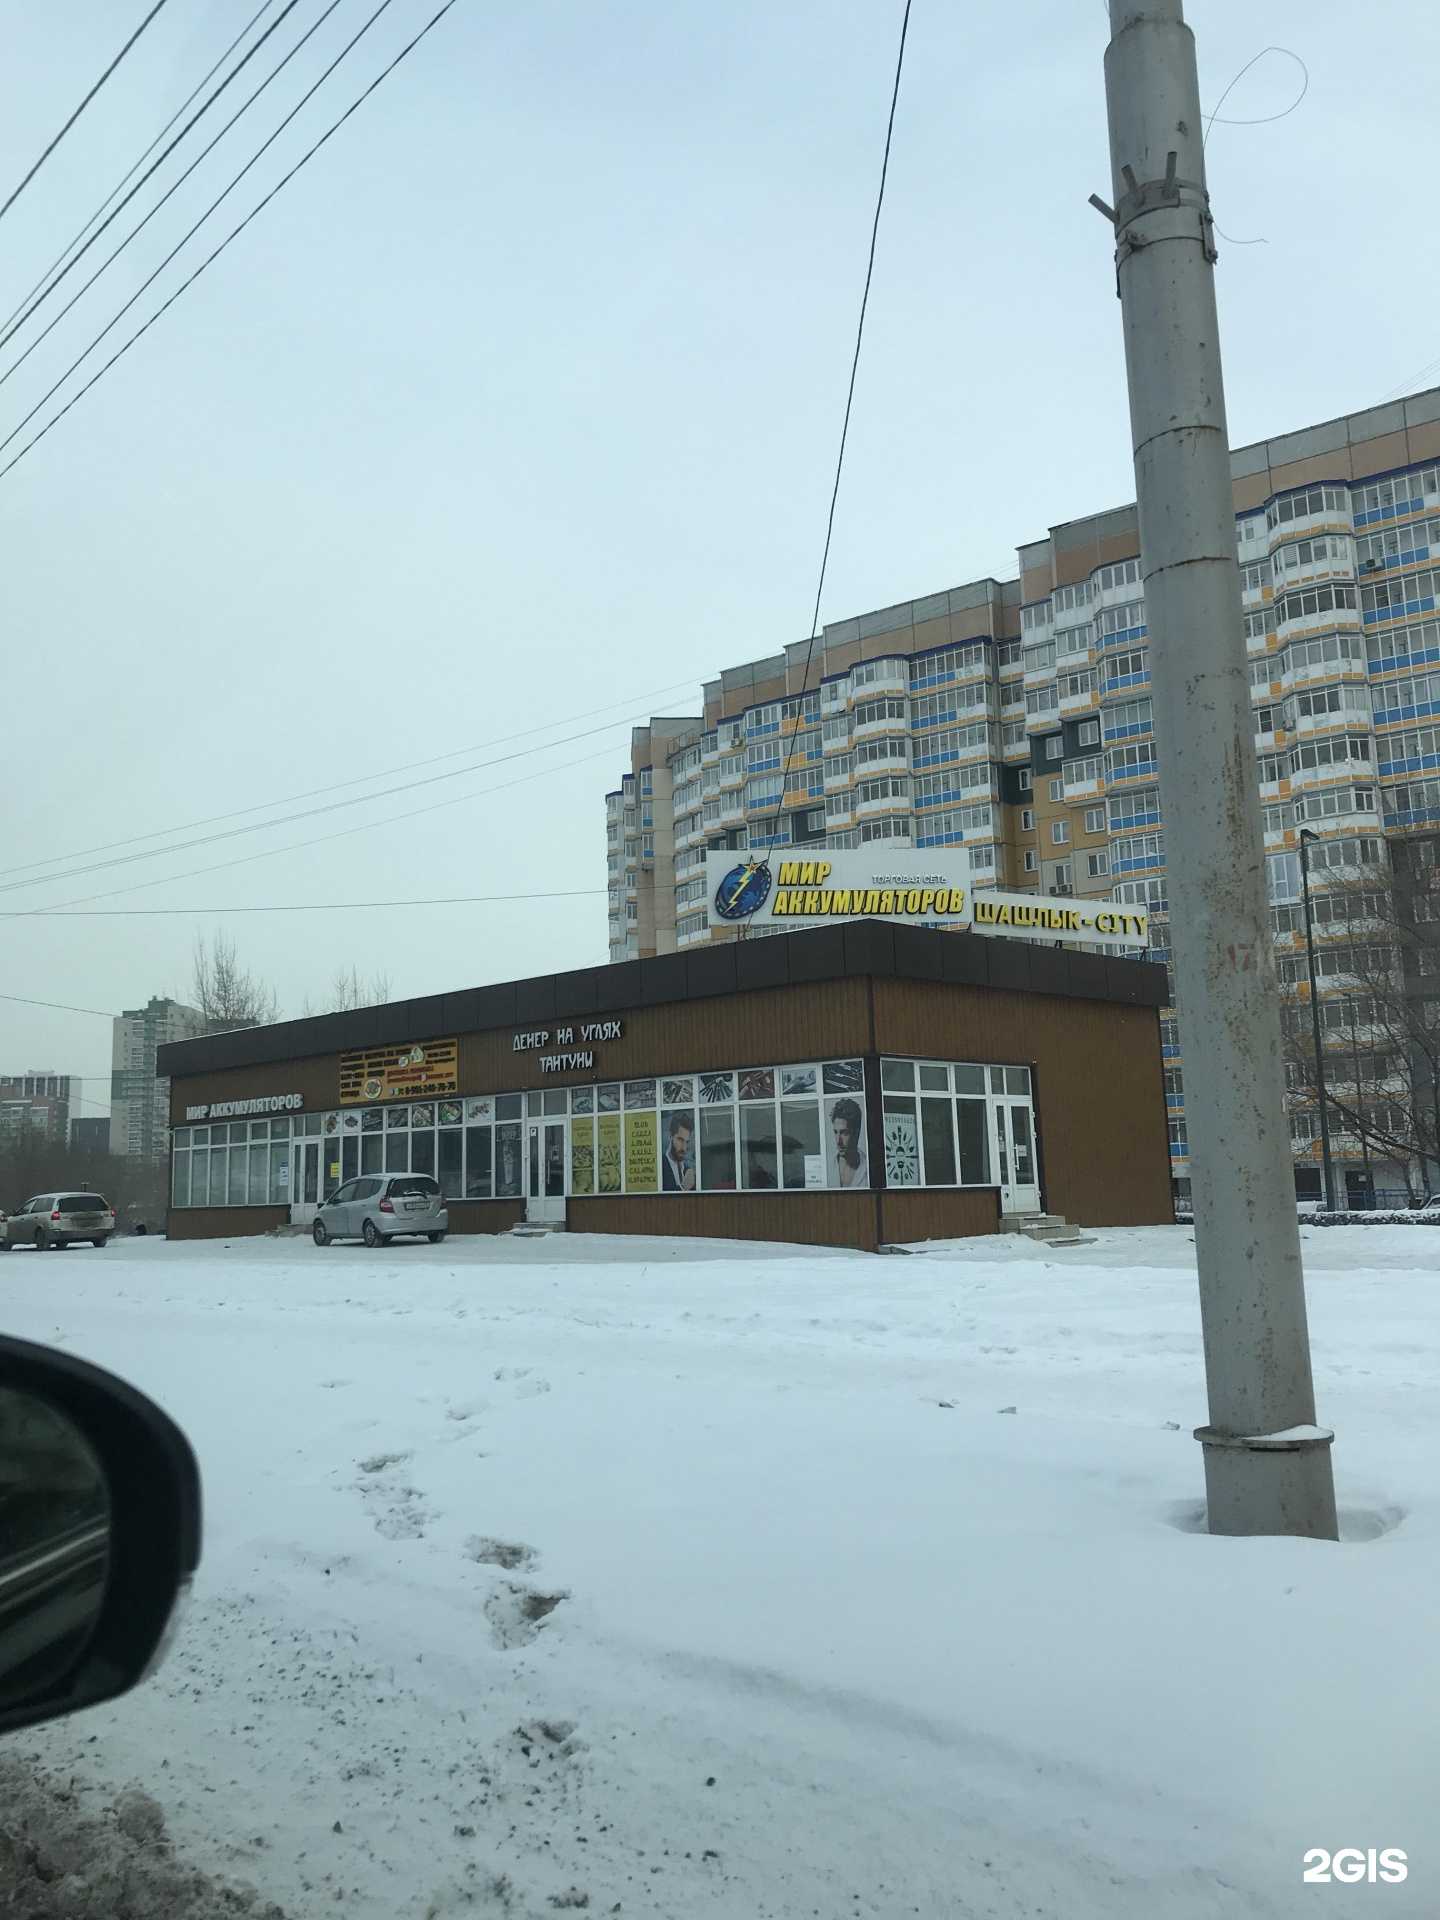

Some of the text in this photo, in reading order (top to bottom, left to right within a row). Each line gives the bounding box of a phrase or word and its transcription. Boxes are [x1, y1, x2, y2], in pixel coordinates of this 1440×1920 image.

[777, 861, 832, 886] МИР
[872, 874, 947, 884] ТОРГОВАЯ СЕТЬ
[772, 888, 965, 915] АККУМУЛЯТОРОВ
[513, 1020, 621, 1051] ДЕНЕР НА УГЛЯХ
[539, 1051, 593, 1073] ТАНТУНИ
[186, 1093, 303, 1121] МИР АККУМУЛЯТОРОВ
